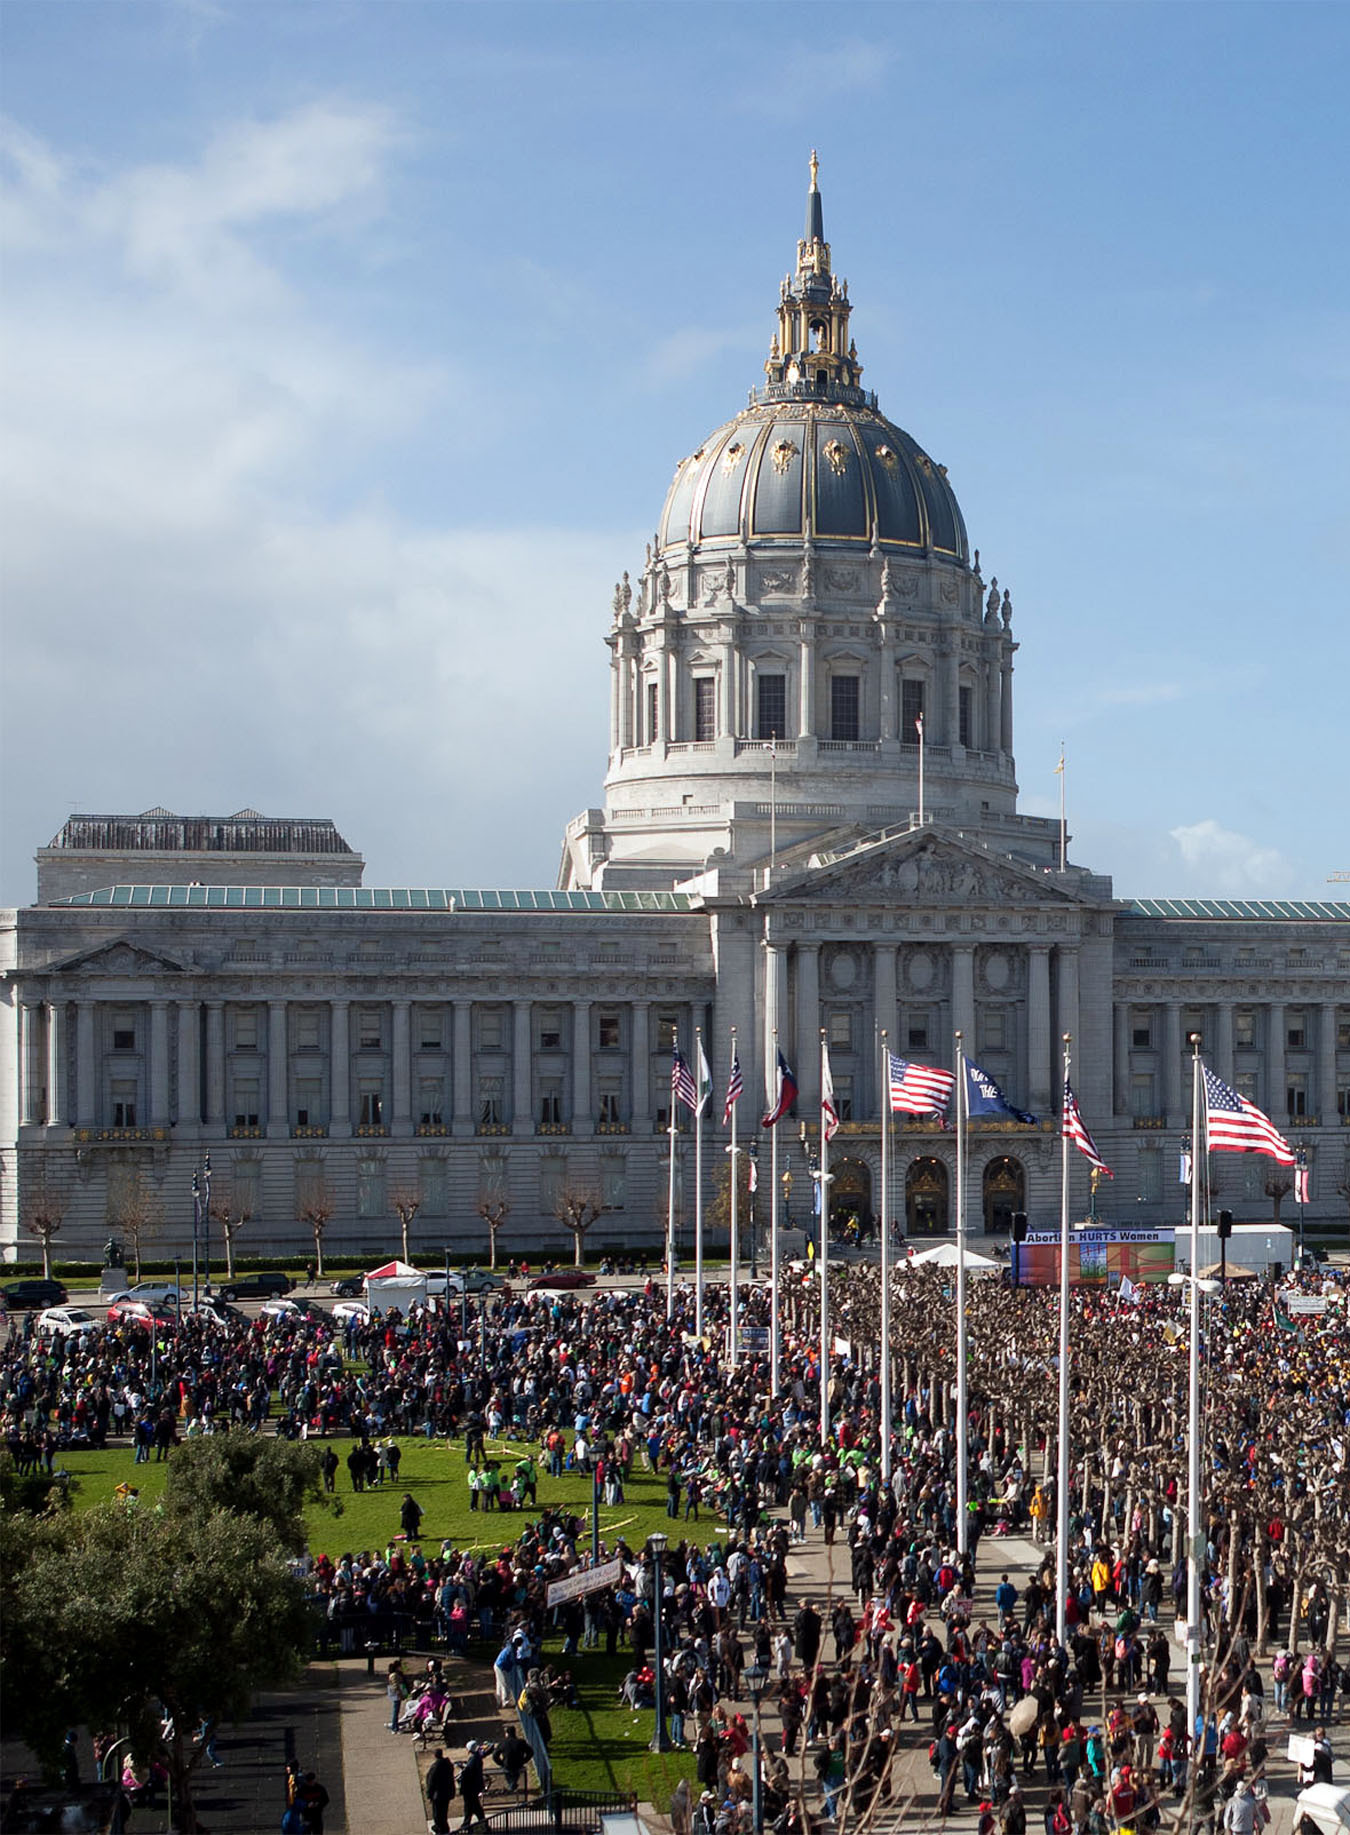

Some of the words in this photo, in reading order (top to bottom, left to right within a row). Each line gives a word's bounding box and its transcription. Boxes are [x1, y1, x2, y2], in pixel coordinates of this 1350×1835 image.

[979, 1084, 998, 1099] THE
[1027, 1234, 1075, 1243] Abortin
[1079, 1232, 1117, 1241] HURTS
[1120, 1231, 1159, 1241] Women
